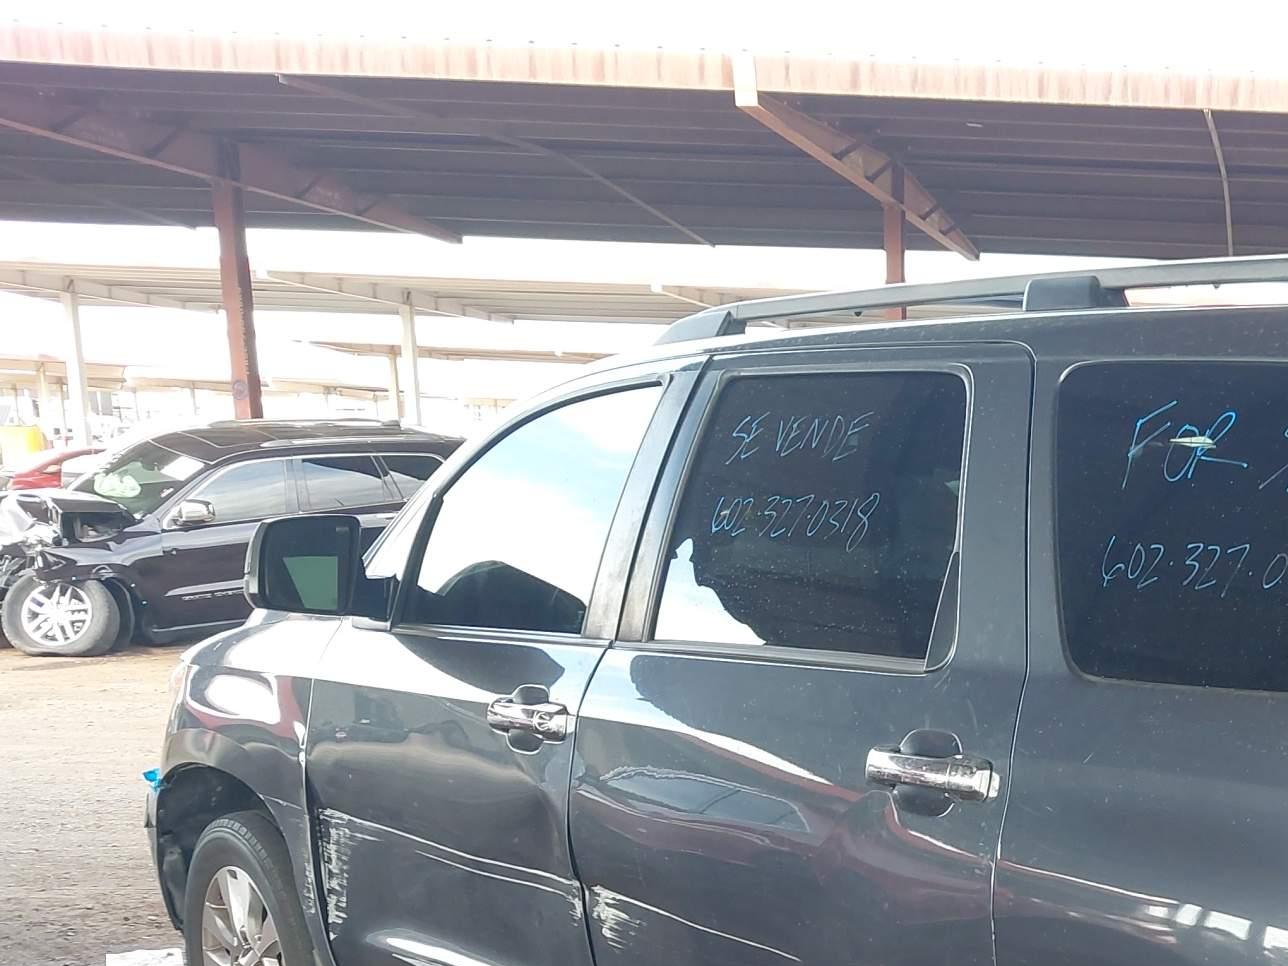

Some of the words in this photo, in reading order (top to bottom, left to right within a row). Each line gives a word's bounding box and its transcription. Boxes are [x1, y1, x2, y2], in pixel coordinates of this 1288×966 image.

[725, 411, 770, 465] SE
[775, 411, 875, 462] VENDE
[1121, 400, 1249, 489] FOR
